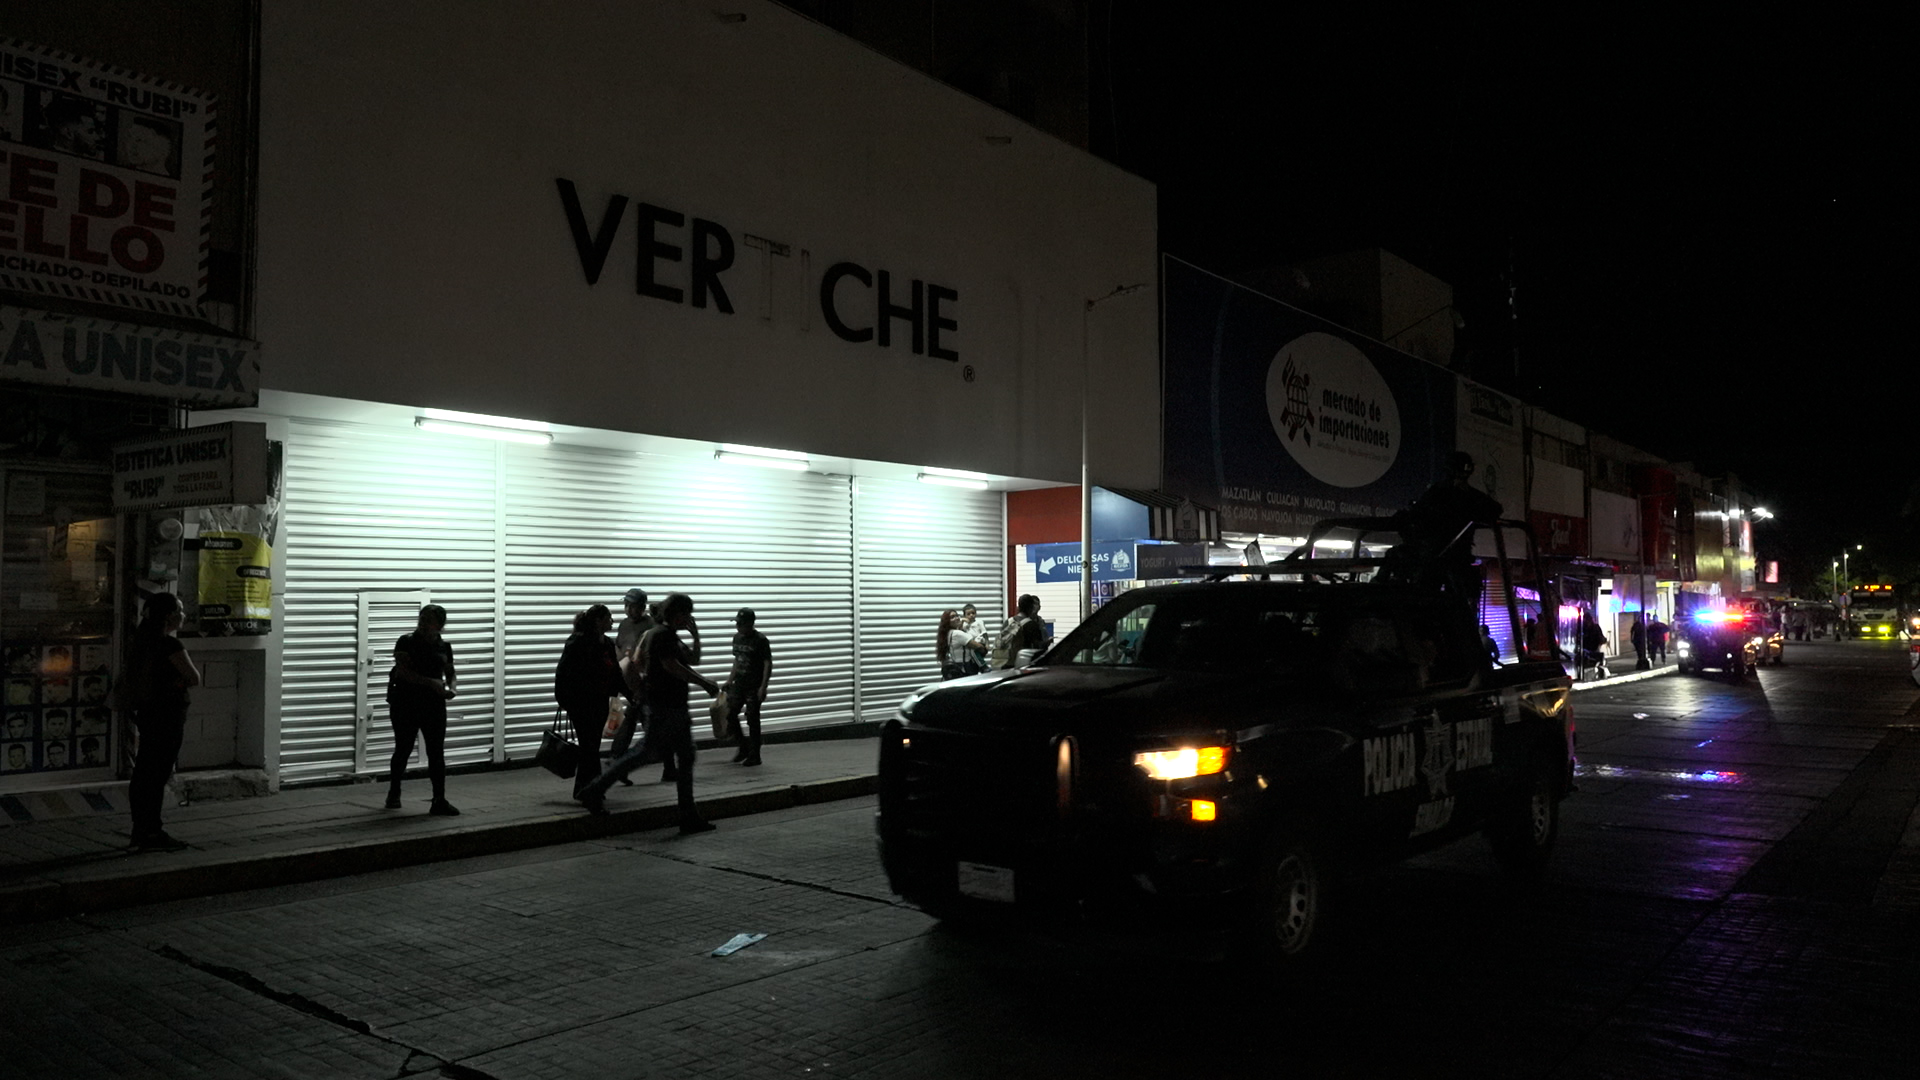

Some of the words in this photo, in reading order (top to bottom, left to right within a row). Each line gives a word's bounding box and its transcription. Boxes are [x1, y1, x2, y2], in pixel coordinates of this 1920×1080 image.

[0, 51, 82, 92] ISEX
[0, 150, 58, 209] E
[78, 167, 177, 233] DE
[0, 256, 191, 298] CHADO-DEPILADO
[63, 326, 247, 392] UNISEX
[1323, 388, 1366, 418] mercado
[1369, 399, 1381, 422] de
[1319, 406, 1390, 448] importaciones
[177, 438, 227, 465] UNISEX
[1233, 505, 1258, 520] CABOS
[1057, 553, 1110, 565] DELICSAS
[1067, 562, 1099, 574] NIEES
[1140, 556, 1166, 568] YOGURT
